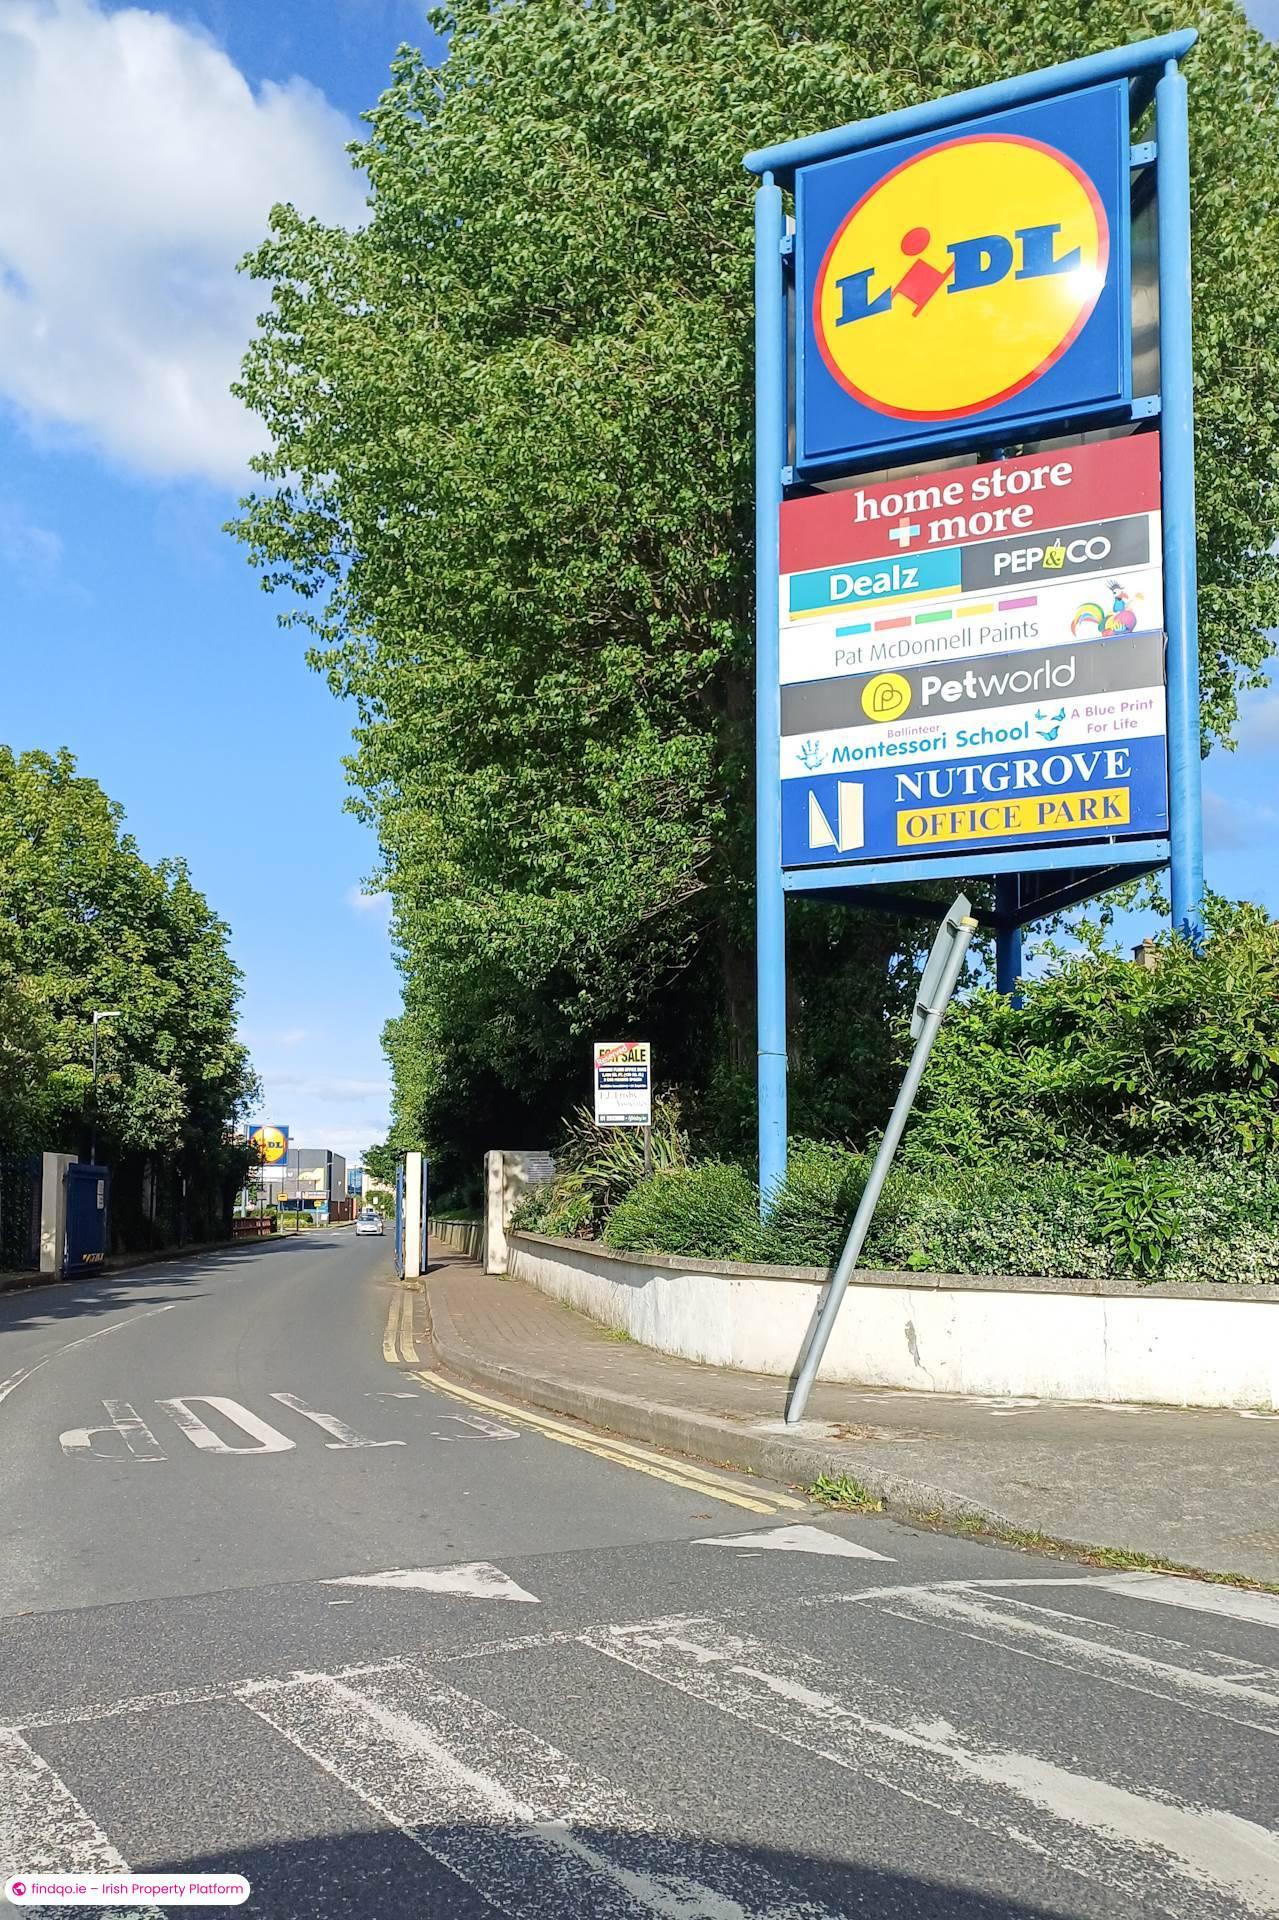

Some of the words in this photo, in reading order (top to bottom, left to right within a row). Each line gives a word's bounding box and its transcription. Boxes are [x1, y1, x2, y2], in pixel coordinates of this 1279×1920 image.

[853, 480, 963, 523] home
[971, 462, 1073, 501] store
[928, 504, 1034, 544] more
[829, 565, 919, 601] Dealz
[835, 646, 863, 667] Pat
[870, 629, 971, 662] McDonnell
[980, 620, 1038, 644] Paints
[921, 655, 1075, 706] Petworld
[1070, 708, 1081, 720] A
[1085, 704, 1116, 719] Blue
[1121, 698, 1154, 715] Print
[1087, 720, 1109, 734] For
[1113, 717, 1138, 732] Life
[832, 730, 947, 764] Montessori
[956, 721, 1029, 748] School
[887, 723, 941, 739] Ballinteer
[895, 747, 1132, 803] NUTGROVE
[906, 804, 1021, 838] OFFICE
[1037, 794, 1123, 826] PARK
[621, 1049, 647, 1062] SALE
